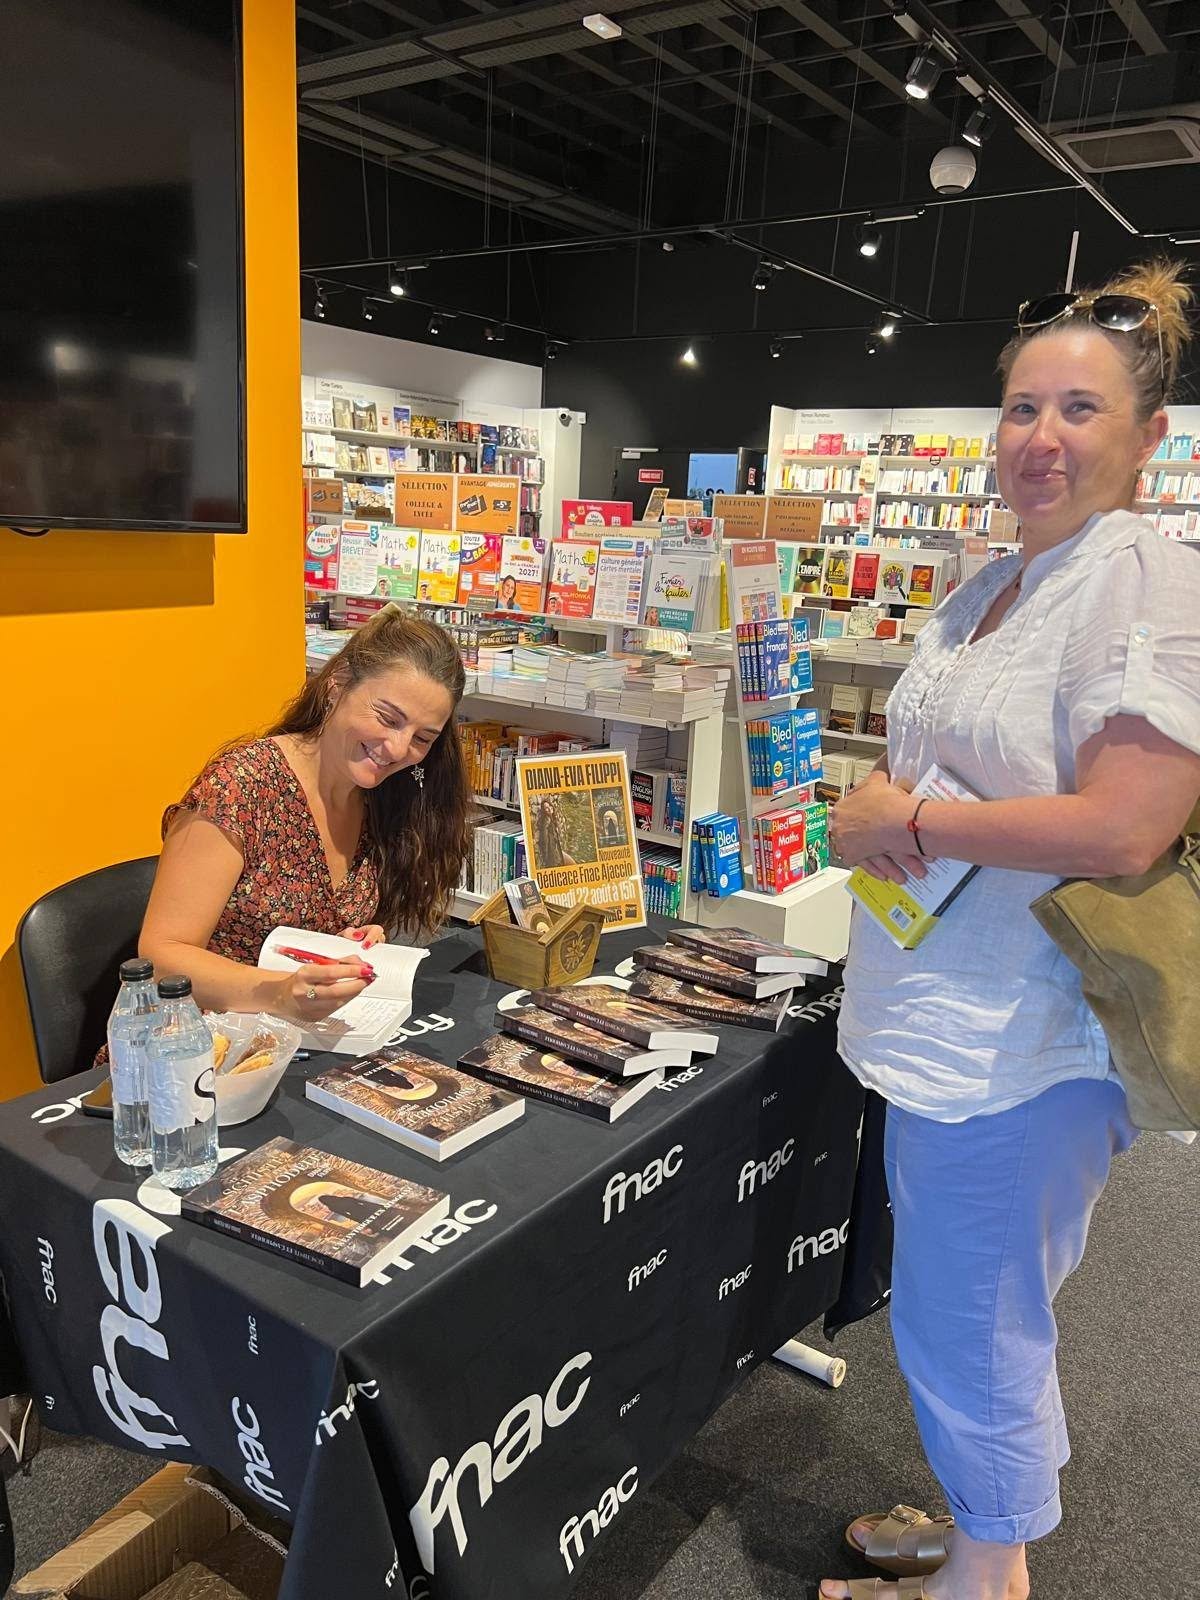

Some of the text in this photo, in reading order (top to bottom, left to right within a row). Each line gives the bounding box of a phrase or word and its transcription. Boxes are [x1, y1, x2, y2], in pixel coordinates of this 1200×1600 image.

[472, 543, 489, 560] BAC
[554, 548, 587, 566] Maths
[600, 557, 642, 568] culture générale
[600, 565, 642, 574] cartes mentales
[763, 624, 778, 637] Bled
[766, 639, 788, 653] Français
[794, 714, 807, 728] Bled
[771, 722, 792, 744] Bled
[525, 764, 586, 791] DIANA-EVA
[585, 761, 622, 785] FILIPPI
[632, 783, 652, 796] ENGLISH
[772, 817, 789, 833] Bled
[717, 825, 738, 848] Bled
[778, 831, 800, 847] Maths
[599, 847, 631, 863] Nouveauté
[536, 862, 633, 890] Dédicace Fnac Ajaccio
[541, 886, 577, 908] amedi
[576, 886, 590, 905] 22
[590, 884, 611, 903] août
[611, 880, 619, 902] à
[618, 878, 636, 900] 15h
[655, 1064, 704, 1093] fnac
[762, 1091, 778, 1108] fnac
[814, 1151, 828, 1167] fnac
[737, 1138, 795, 1203] fnac
[602, 1144, 684, 1224] fnac
[37, 1237, 58, 1304] fnac
[628, 1249, 668, 1292] fnac
[718, 1264, 752, 1301] fnac
[247, 1314, 257, 1357] fnac
[736, 1350, 755, 1370] fnac
[620, 1392, 641, 1417] fnac
[231, 1396, 292, 1513] fnac
[409, 1351, 593, 1576] fnac
[559, 1465, 639, 1575] fnac
